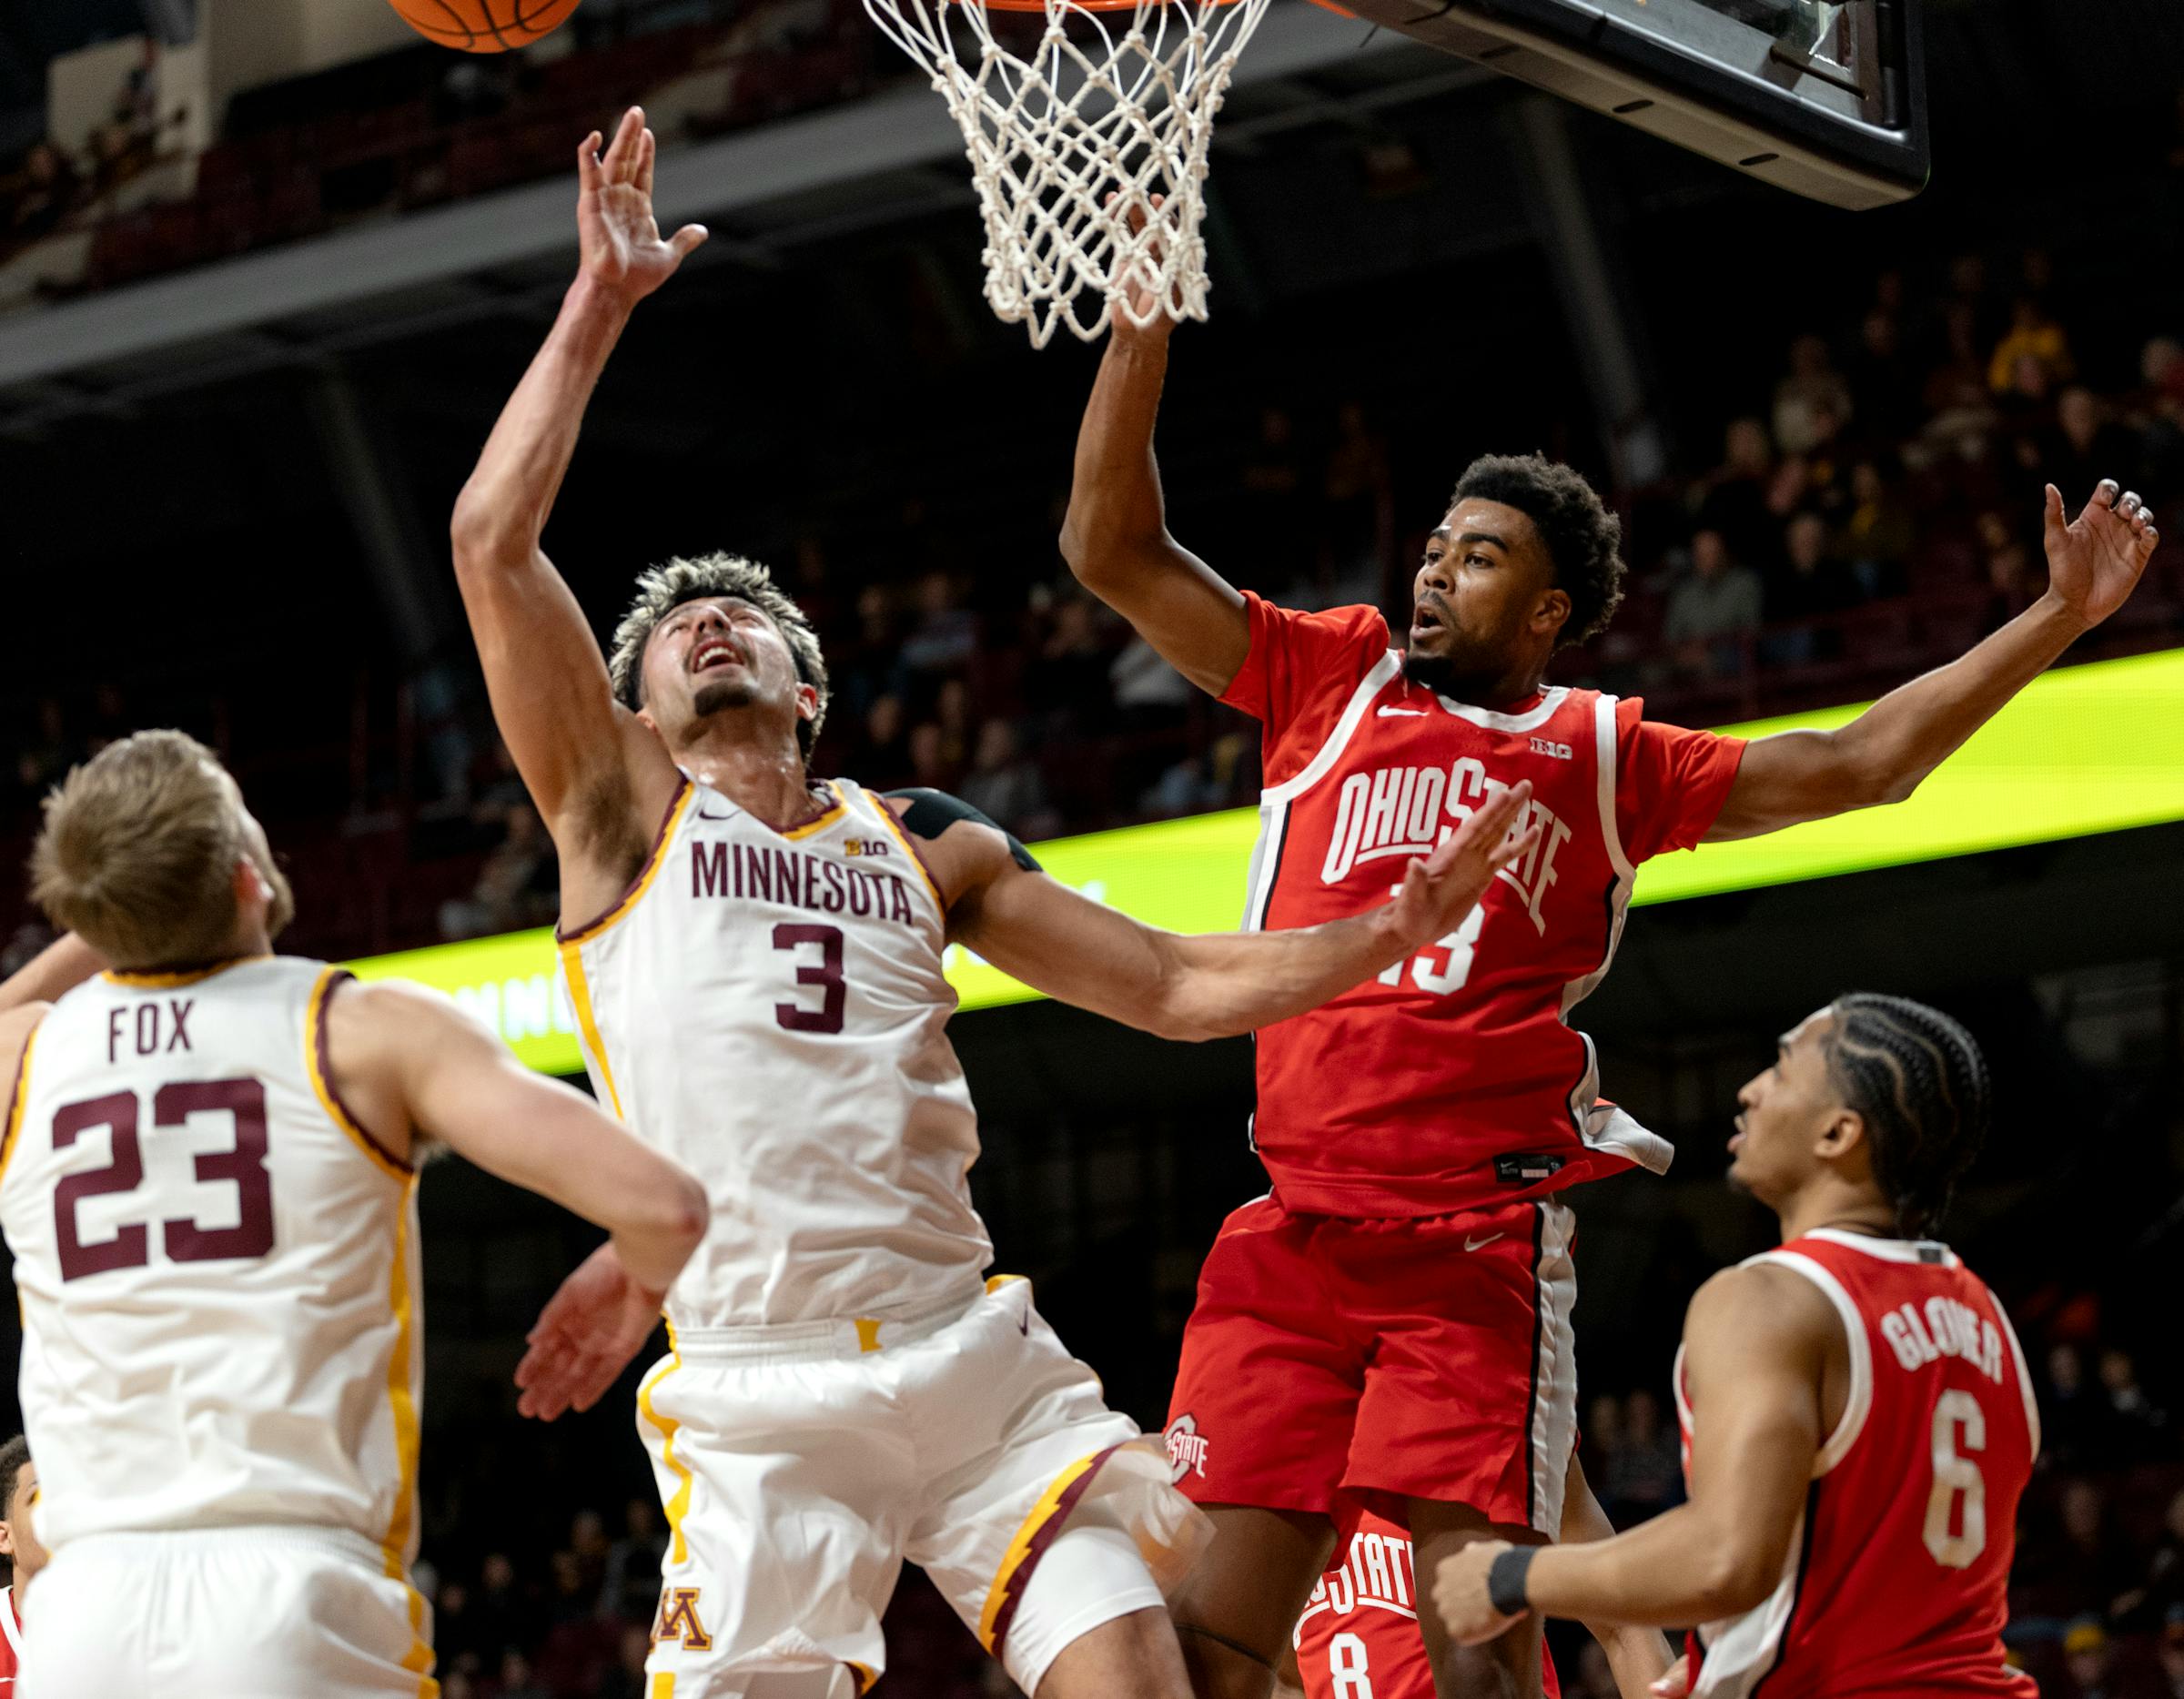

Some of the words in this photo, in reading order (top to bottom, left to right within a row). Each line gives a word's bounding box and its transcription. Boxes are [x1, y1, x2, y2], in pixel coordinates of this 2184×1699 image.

[692, 841, 912, 925] MINNESOTA
[773, 923, 846, 1034] 3
[108, 999, 195, 1064] FOX
[52, 1076, 275, 1284] 23
[1922, 1388, 1986, 1570] 6
[1328, 1532, 1418, 1615] STAT
[1329, 1632, 1375, 1699] 8
